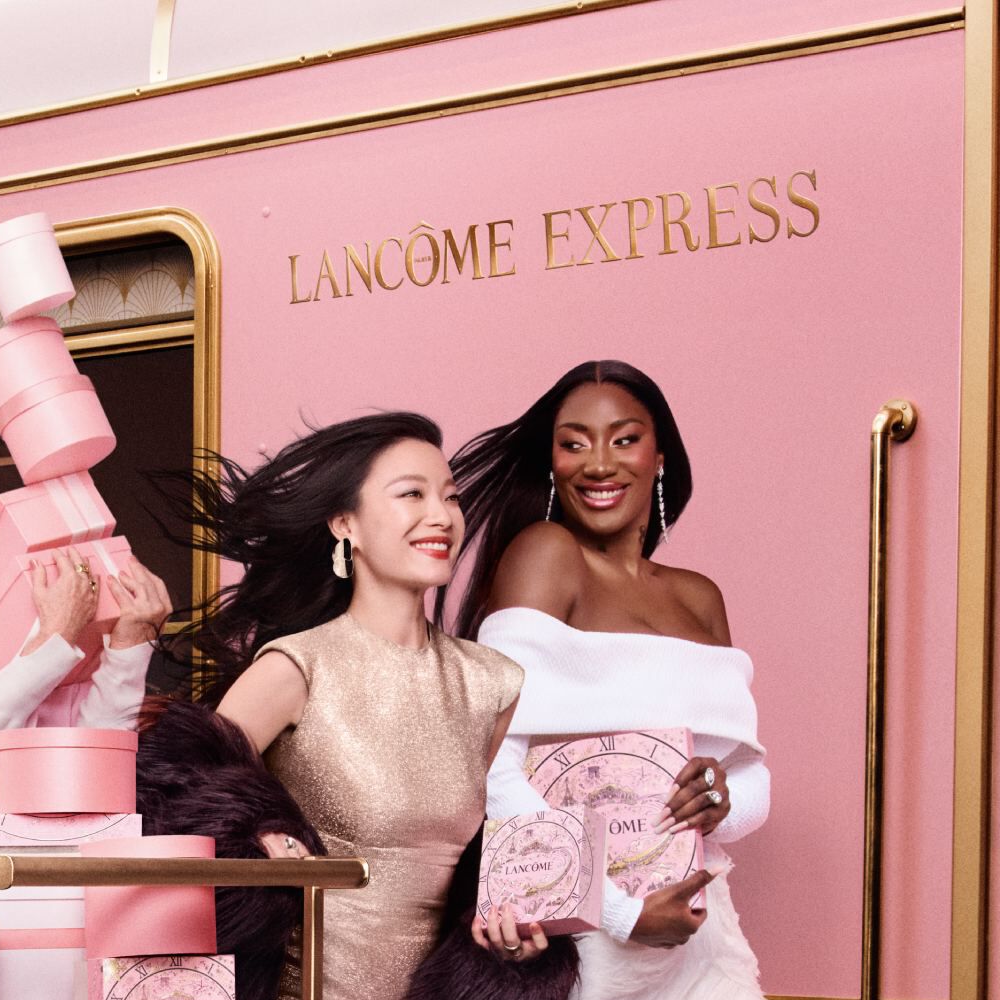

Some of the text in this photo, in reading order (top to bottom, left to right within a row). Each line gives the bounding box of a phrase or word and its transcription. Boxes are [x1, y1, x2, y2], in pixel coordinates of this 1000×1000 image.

[288, 168, 821, 305] LANCÔME EXPRESS
[554, 752, 571, 770] XI
[609, 818, 647, 834] ÔME
[505, 861, 553, 875] LANCÔME
[135, 965, 148, 978] XI
